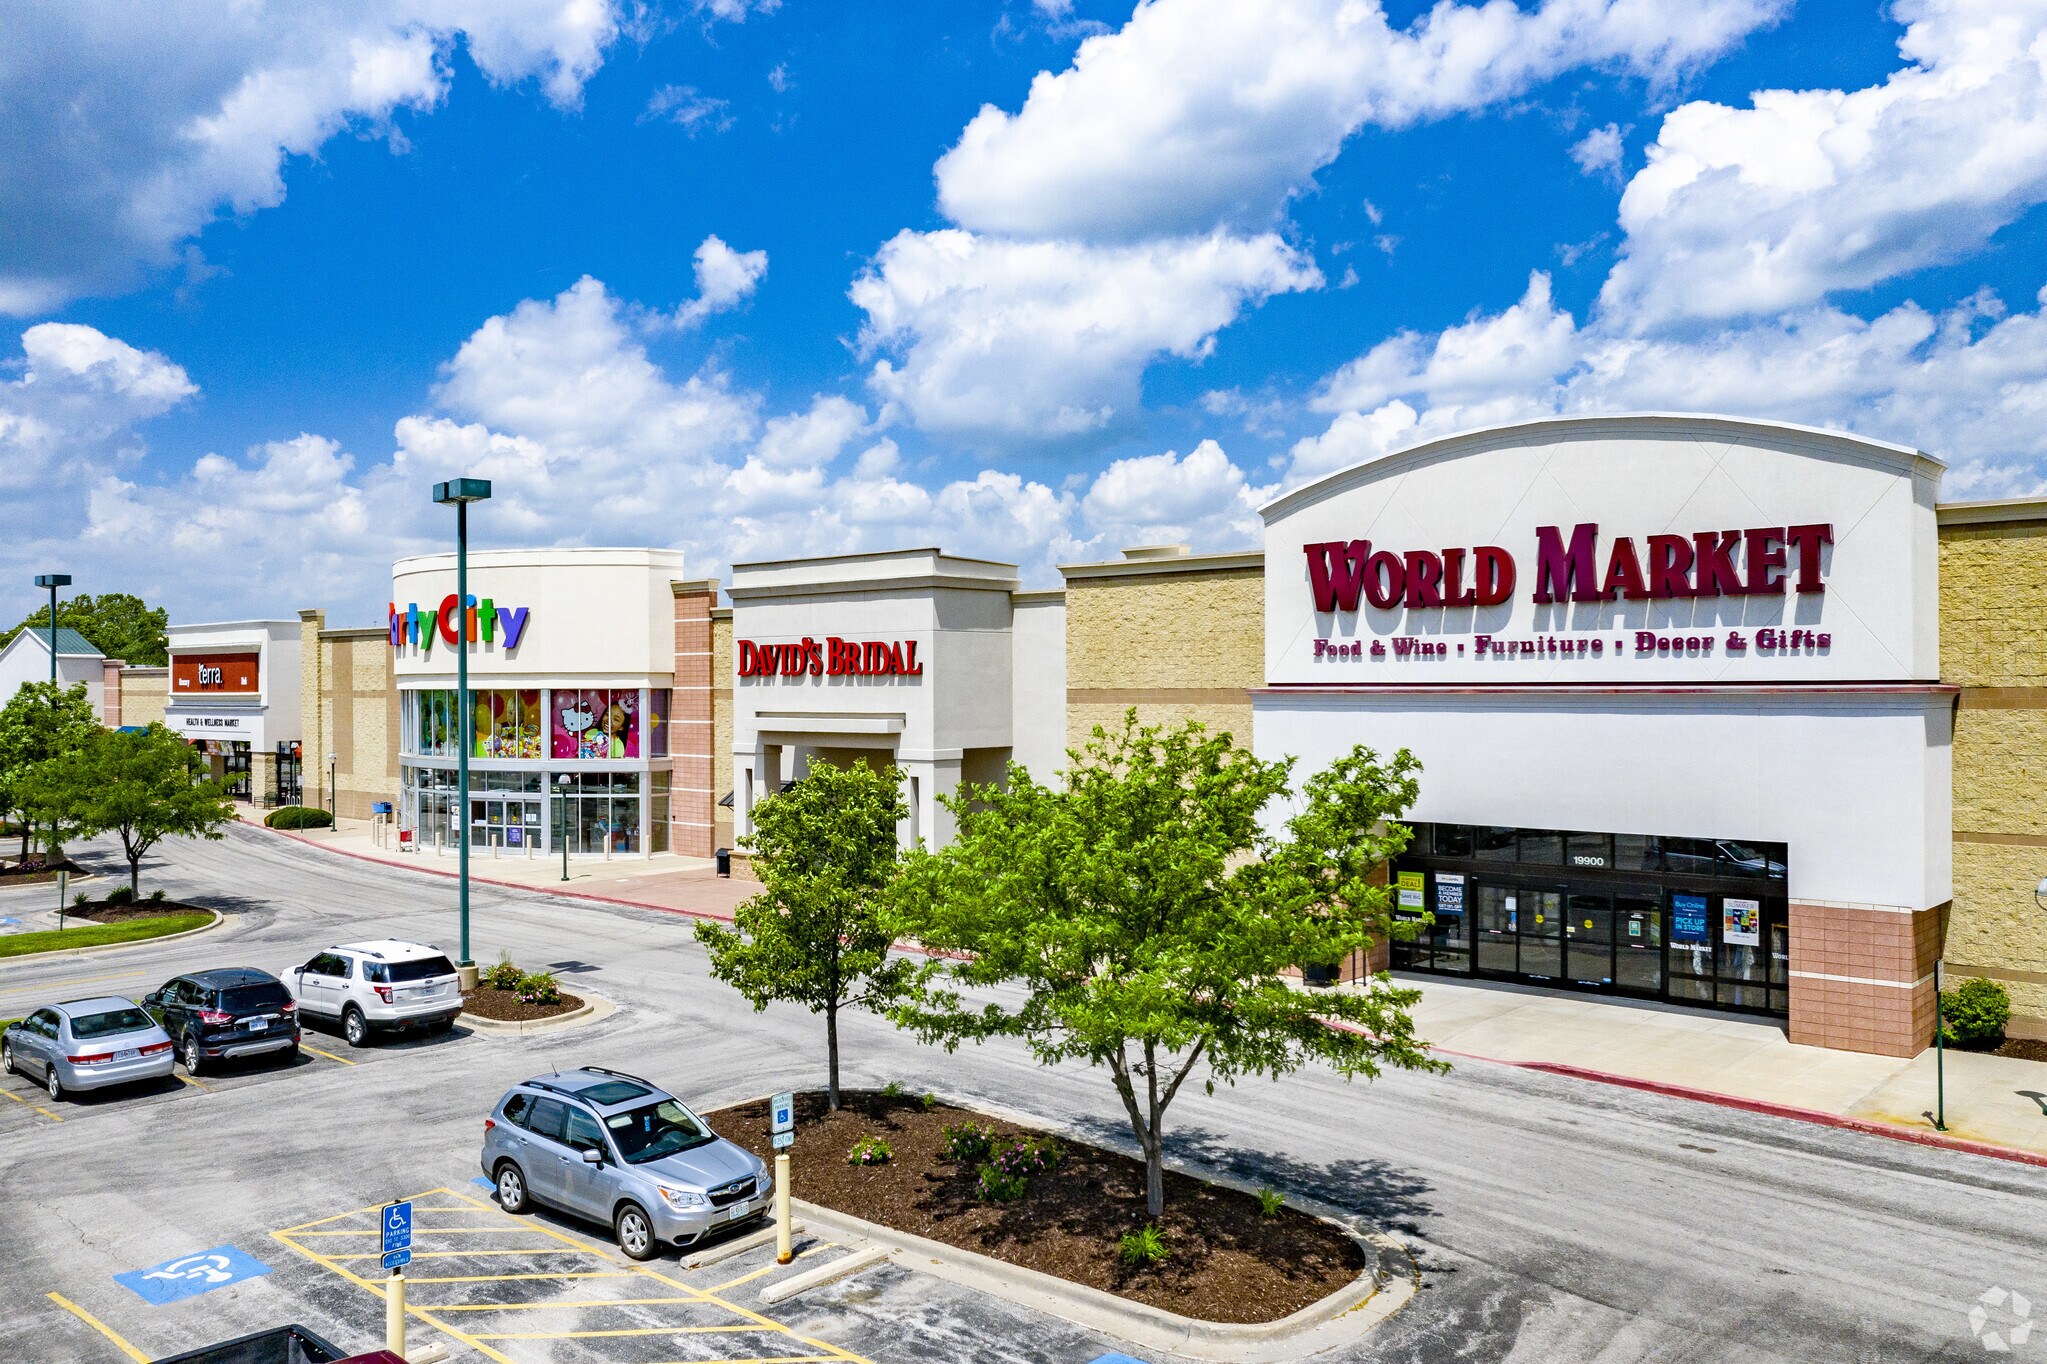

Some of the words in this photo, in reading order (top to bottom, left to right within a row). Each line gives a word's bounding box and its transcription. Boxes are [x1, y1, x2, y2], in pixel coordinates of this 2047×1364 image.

[1303, 539, 1516, 612] WORLD
[1533, 523, 1835, 604] MARKET
[1313, 639, 1362, 656] Food
[1369, 640, 1387, 656] &
[1392, 637, 1447, 655] Wine
[1475, 635, 1604, 655] Furniture
[1635, 631, 1715, 652] Decor
[1726, 631, 1747, 650] &
[1756, 628, 1832, 651] Gifts
[826, 637, 923, 675] BRIDAL
[186, 718, 199, 726] HEALTH
[204, 719, 223, 727] WELLNESS
[224, 719, 240, 727] MARKET
[1573, 856, 1604, 866] 19900
[1438, 895, 1462, 903] TODAY
[1675, 917, 1693, 925] PICK
[1694, 918, 1705, 926] UP
[385, 1227, 410, 1238] PARKING
[385, 1257, 409, 1267] ACCESSIBLE
